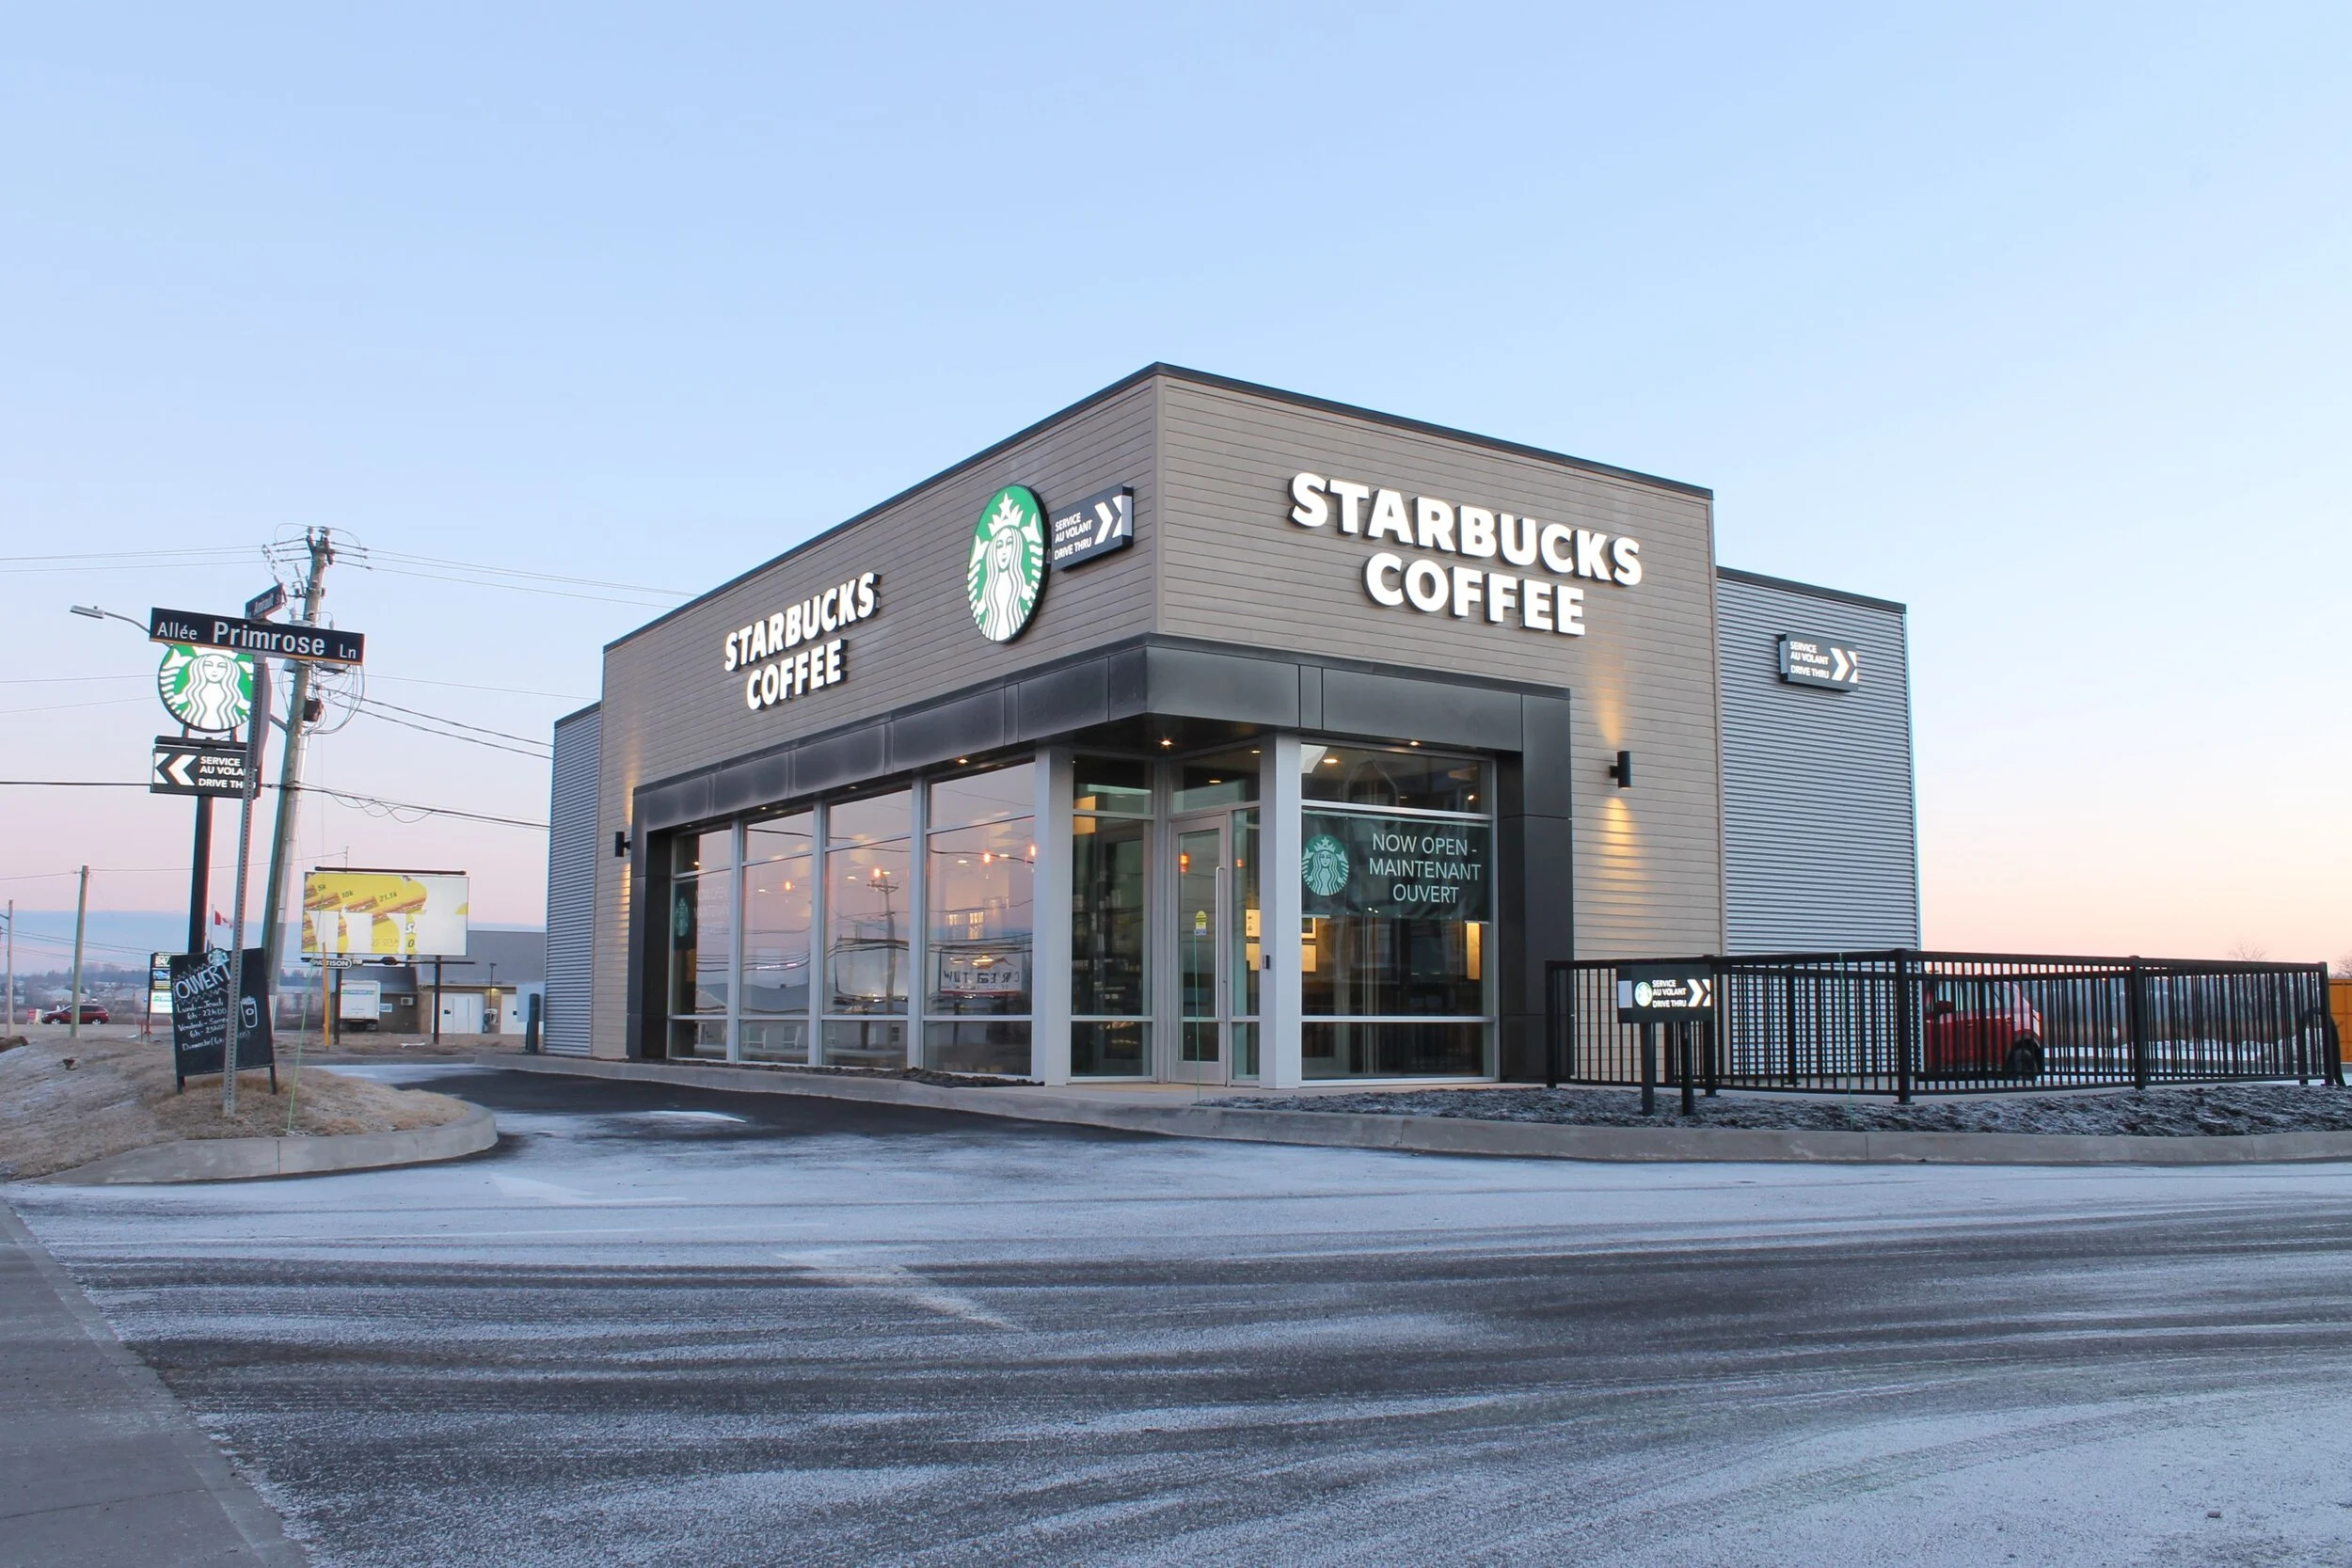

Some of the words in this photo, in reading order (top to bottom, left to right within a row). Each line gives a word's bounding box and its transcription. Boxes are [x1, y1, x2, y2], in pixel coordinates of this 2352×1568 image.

[1055, 512, 1081, 532] SERVICE
[1055, 532, 1065, 544] AU
[1065, 519, 1092, 540] VOLANT
[1290, 472, 1643, 586] STARBUCKS
[1054, 541, 1073, 561] DRIVE
[1073, 537, 1092, 552] THRU
[1363, 552, 1586, 636] COFFEE
[724, 572, 881, 672] STARBUCKS
[157, 622, 198, 641] Allée
[213, 621, 326, 656] Primrose
[340, 643, 357, 658] Ln
[1789, 641, 1817, 654] SERVICE
[1790, 651, 1801, 660] AU
[1801, 653, 1829, 665] VOLANT
[747, 639, 848, 710] COFFEE
[1790, 665, 1811, 676] DRIVE
[1811, 669, 1829, 679] THRU
[199, 756, 241, 767] SERVICE
[199, 766, 215, 774] AU
[199, 778, 228, 788] DRIVE
[1373, 833, 1417, 853] NOW
[1422, 836, 1468, 856] OPEN
[1369, 857, 1482, 880] MAINTENANT
[342, 890, 354, 899] 10k
[1393, 884, 1459, 903] OUVERT
[1652, 979, 1677, 988] SERVICE
[1652, 988, 1662, 996] AU
[1662, 988, 1687, 996] VOLANT
[1652, 999, 1670, 1007] DRIVE
[1671, 999, 1687, 1007] THRU
